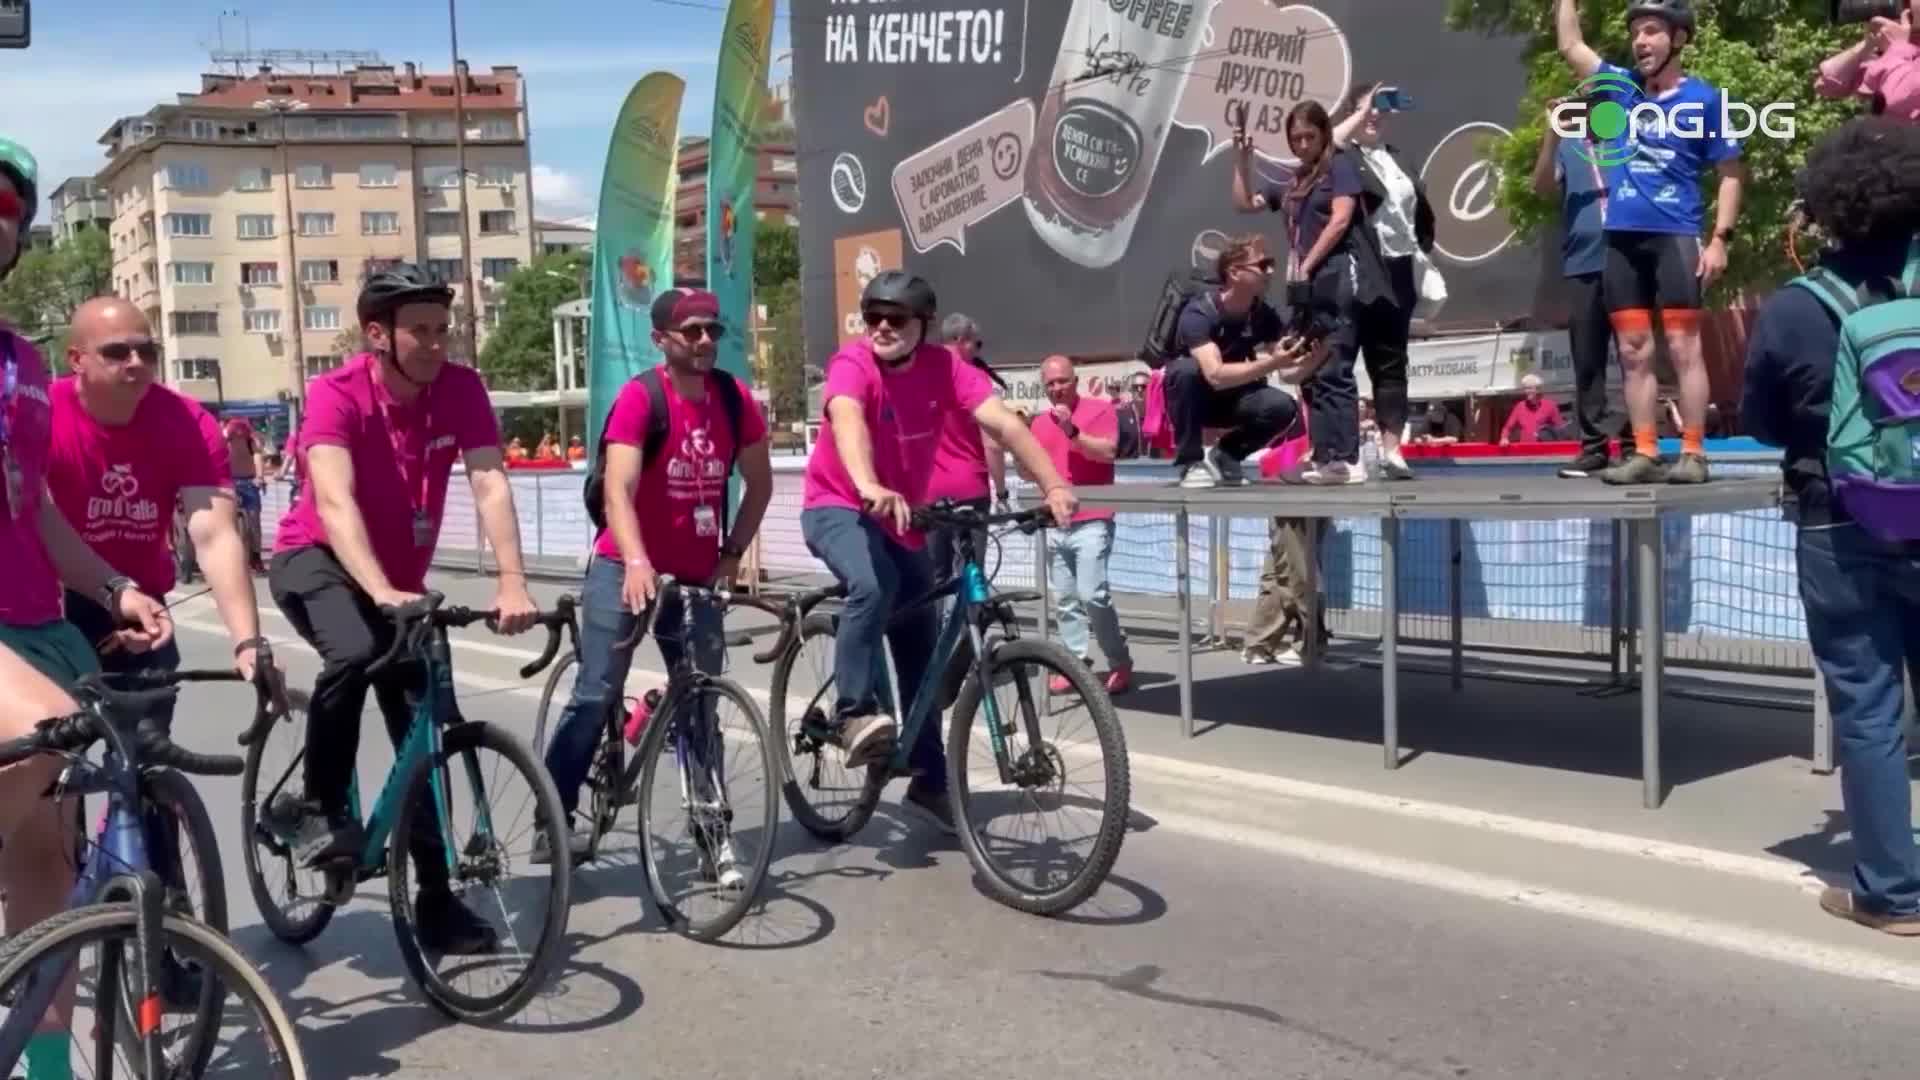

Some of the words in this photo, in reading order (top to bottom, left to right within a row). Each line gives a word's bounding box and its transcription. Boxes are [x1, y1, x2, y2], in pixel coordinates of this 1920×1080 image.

[825, 14, 858, 63] НА
[867, 8, 1005, 64] КЕНЧЕТО!
[1228, 25, 1308, 65] ОТКРИЙ
[1215, 61, 1304, 101] ДРУГОТО
[1255, 104, 1284, 134] АЗ
[910, 156, 953, 194] ЗАПОЧНИ
[957, 138, 984, 170] ДЕНЯ
[929, 164, 980, 205] АРОМАТНО
